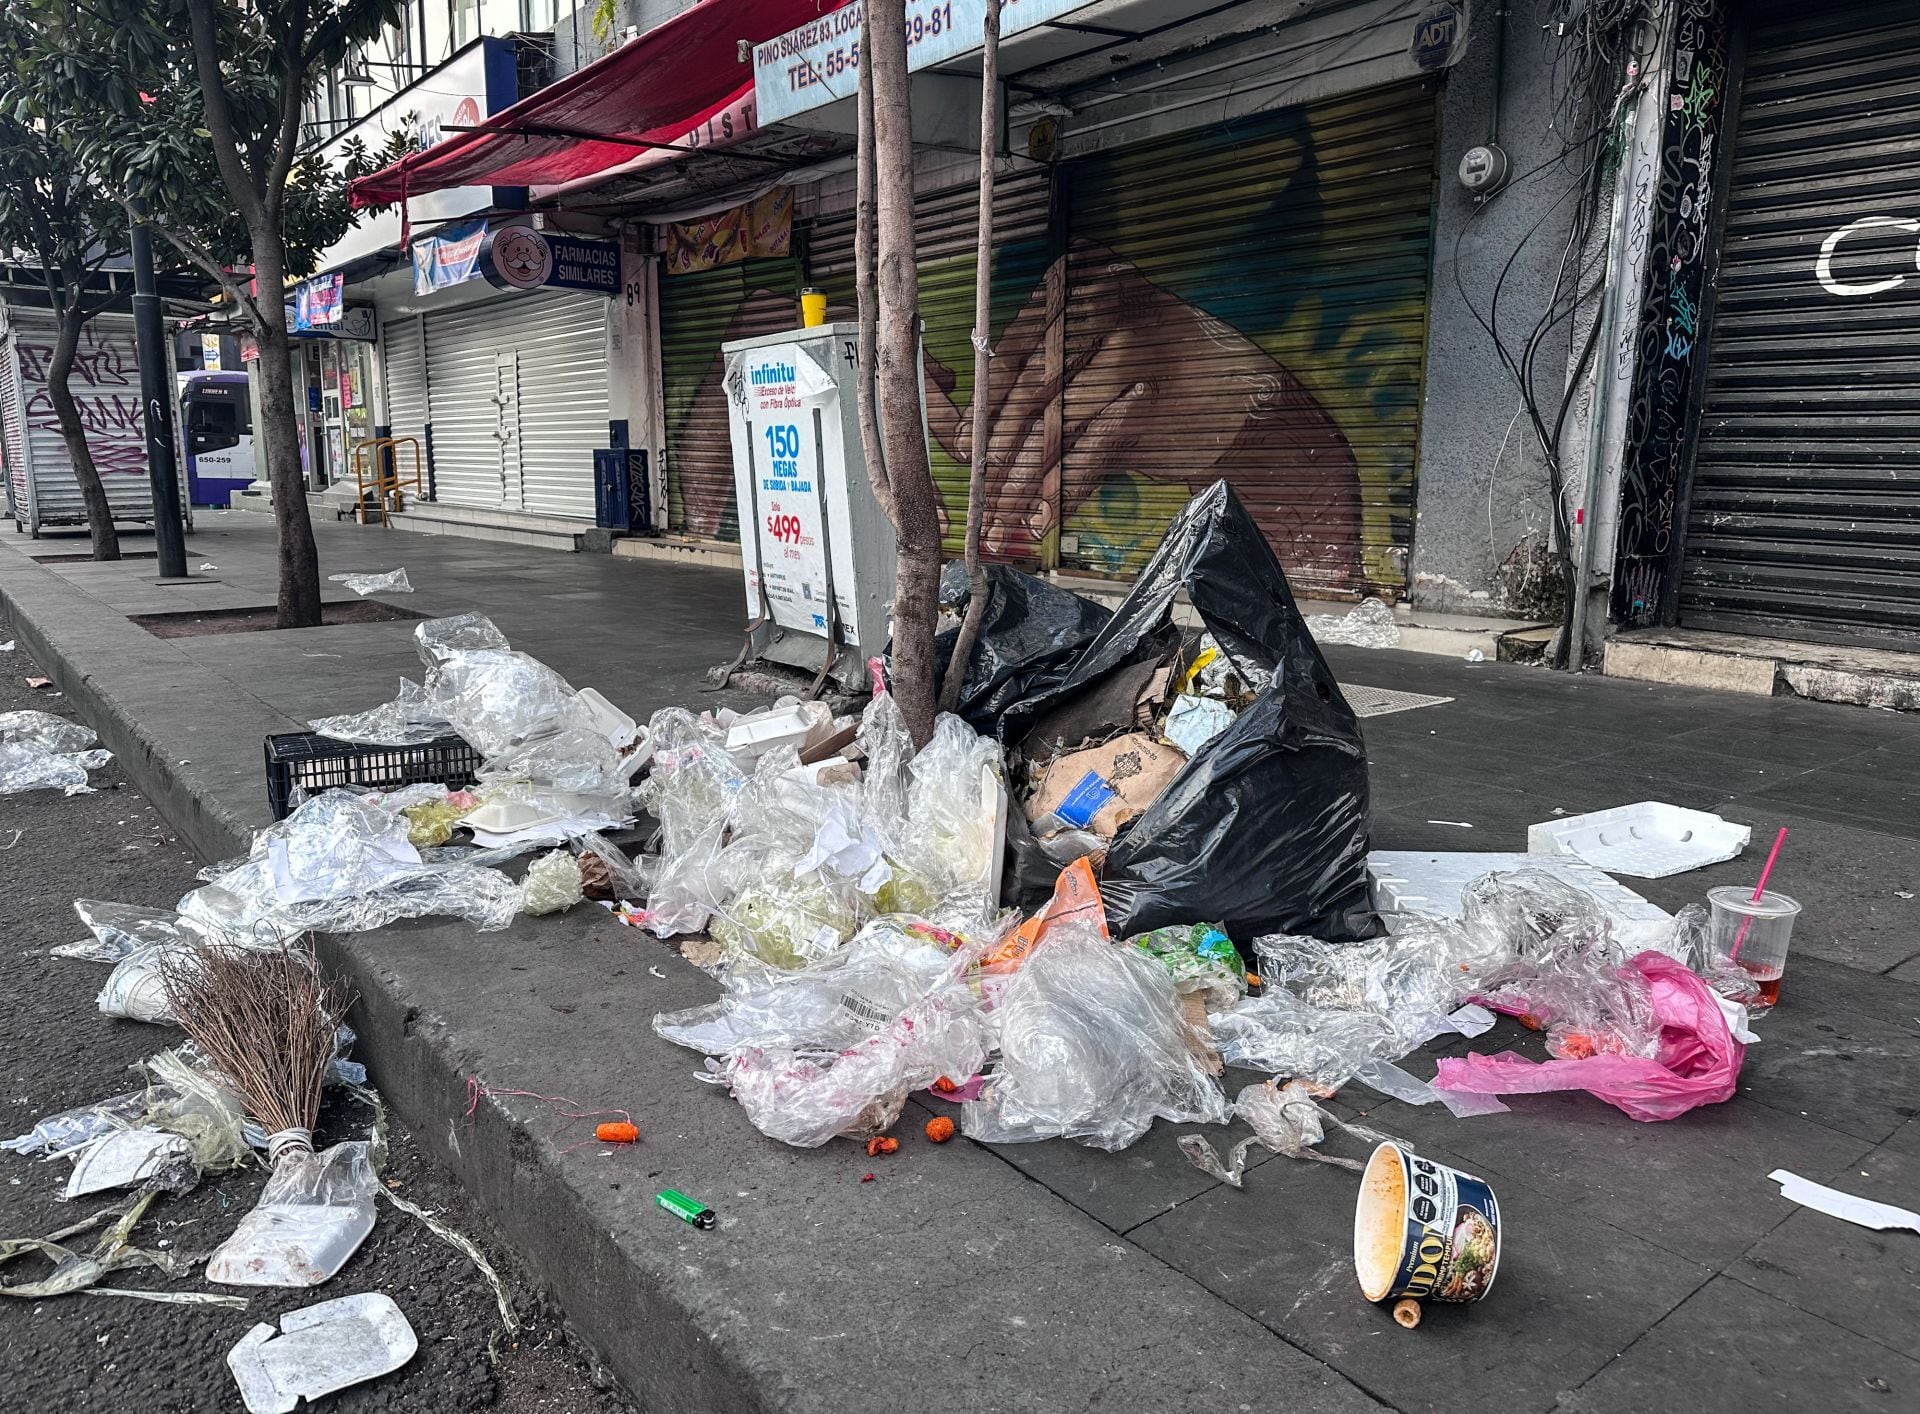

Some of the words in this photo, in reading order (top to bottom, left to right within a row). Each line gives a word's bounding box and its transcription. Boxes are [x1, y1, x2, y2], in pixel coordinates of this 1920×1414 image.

[758, 43, 779, 68] PINO
[781, 27, 818, 58] SUÁREZ
[820, 22, 834, 43] 83,
[835, 7, 862, 35] LOCA
[1420, 19, 1455, 48] ADT
[788, 61, 822, 92] TEL:
[554, 244, 616, 267] FARMACIAS
[558, 266, 615, 286] SIMILARES
[626, 282, 641, 306] 89
[750, 361, 795, 385] infinitu
[765, 424, 799, 459] 150
[199, 456, 232, 464] 650-259
[772, 460, 798, 478] MEGAS
[763, 479, 770, 490] DE
[770, 480, 787, 491] SUBIDA
[790, 480, 811, 492] BAJADA
[767, 514, 801, 545] $499
[1405, 1241, 1419, 1273] Premium
[1433, 1263, 1447, 1288] SHRIMP
[1443, 1234, 1454, 1265] TEMPUR
